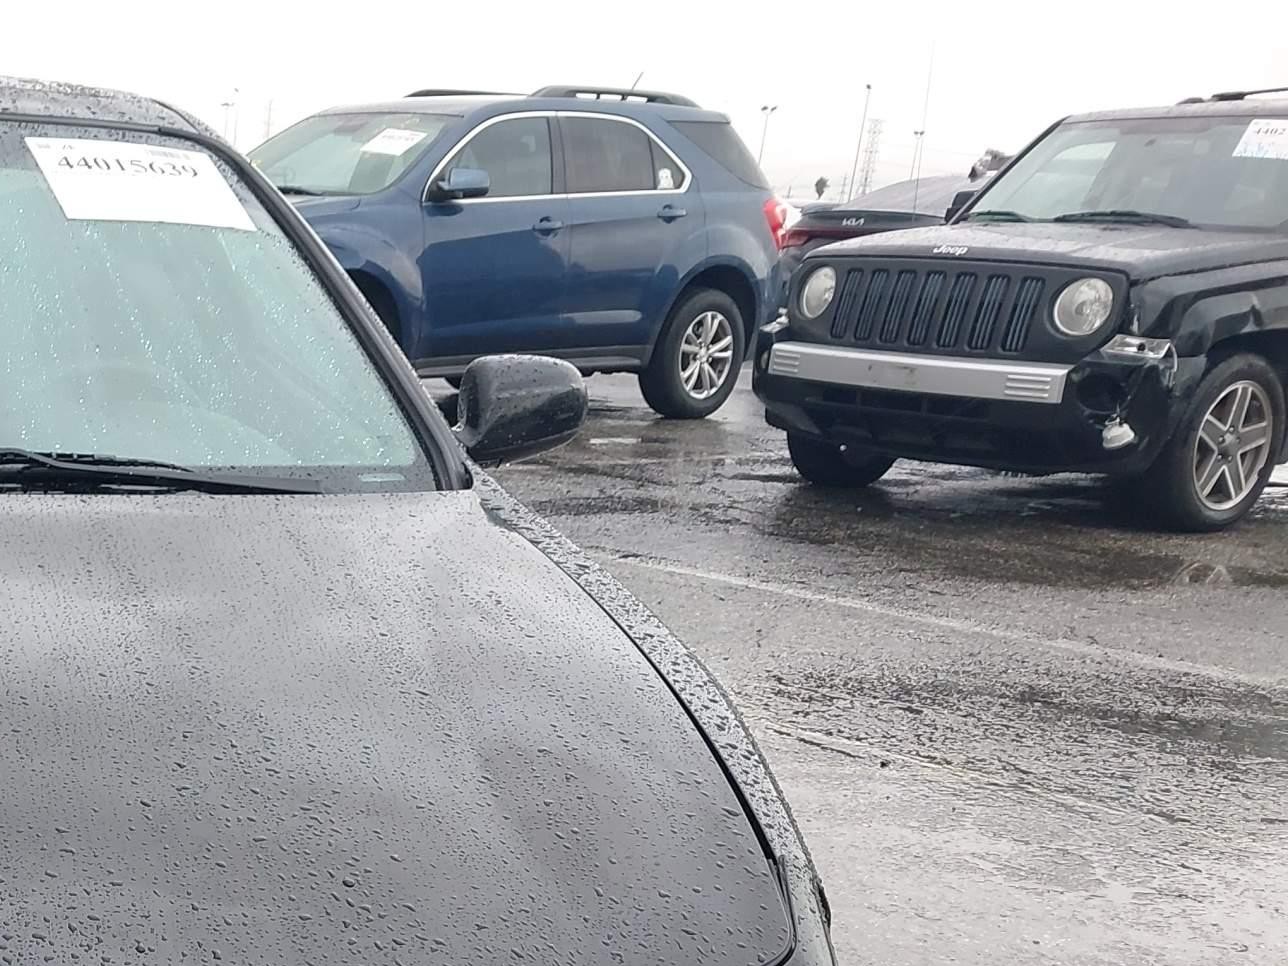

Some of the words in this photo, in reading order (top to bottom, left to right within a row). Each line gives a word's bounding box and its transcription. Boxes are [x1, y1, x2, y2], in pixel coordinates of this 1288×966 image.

[57, 155, 199, 178] 44015639
[842, 217, 865, 226] KIA
[933, 244, 968, 256] Jeep
